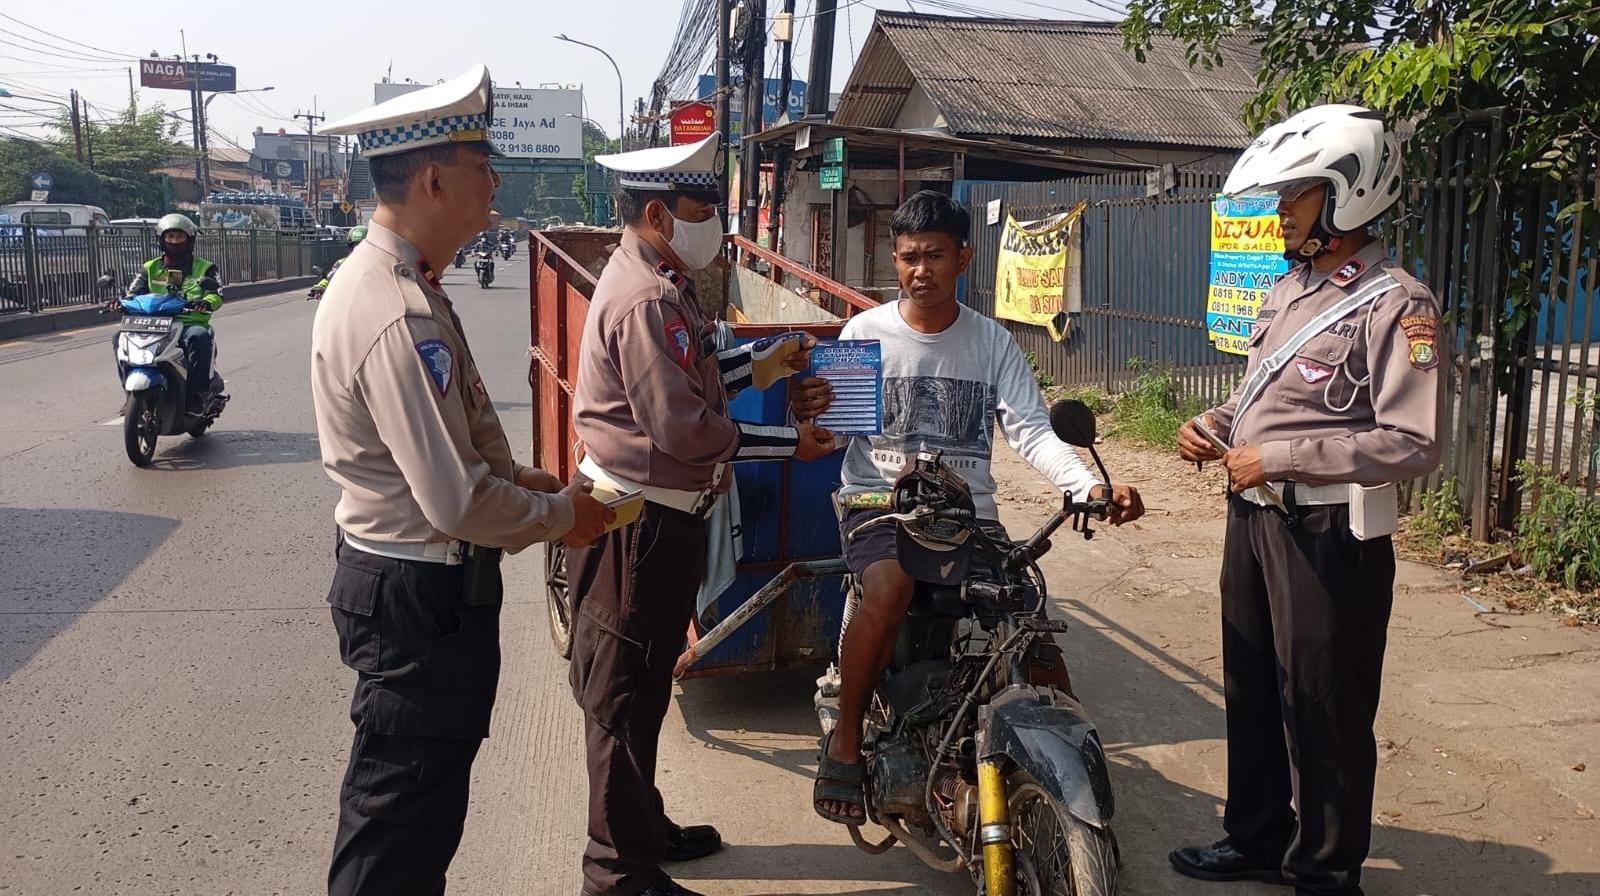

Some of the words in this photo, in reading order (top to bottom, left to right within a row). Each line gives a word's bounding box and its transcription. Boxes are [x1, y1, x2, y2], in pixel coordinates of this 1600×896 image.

[143, 63, 185, 76] NAGA
[539, 117, 556, 128] Ad
[508, 144, 534, 153] 9136
[535, 144, 560, 153] 8800
[1243, 242, 1278, 251] SALE)
[1215, 270, 1247, 285] ANDY
[1237, 290, 1256, 301] 726
[874, 453, 901, 464] ROAD
